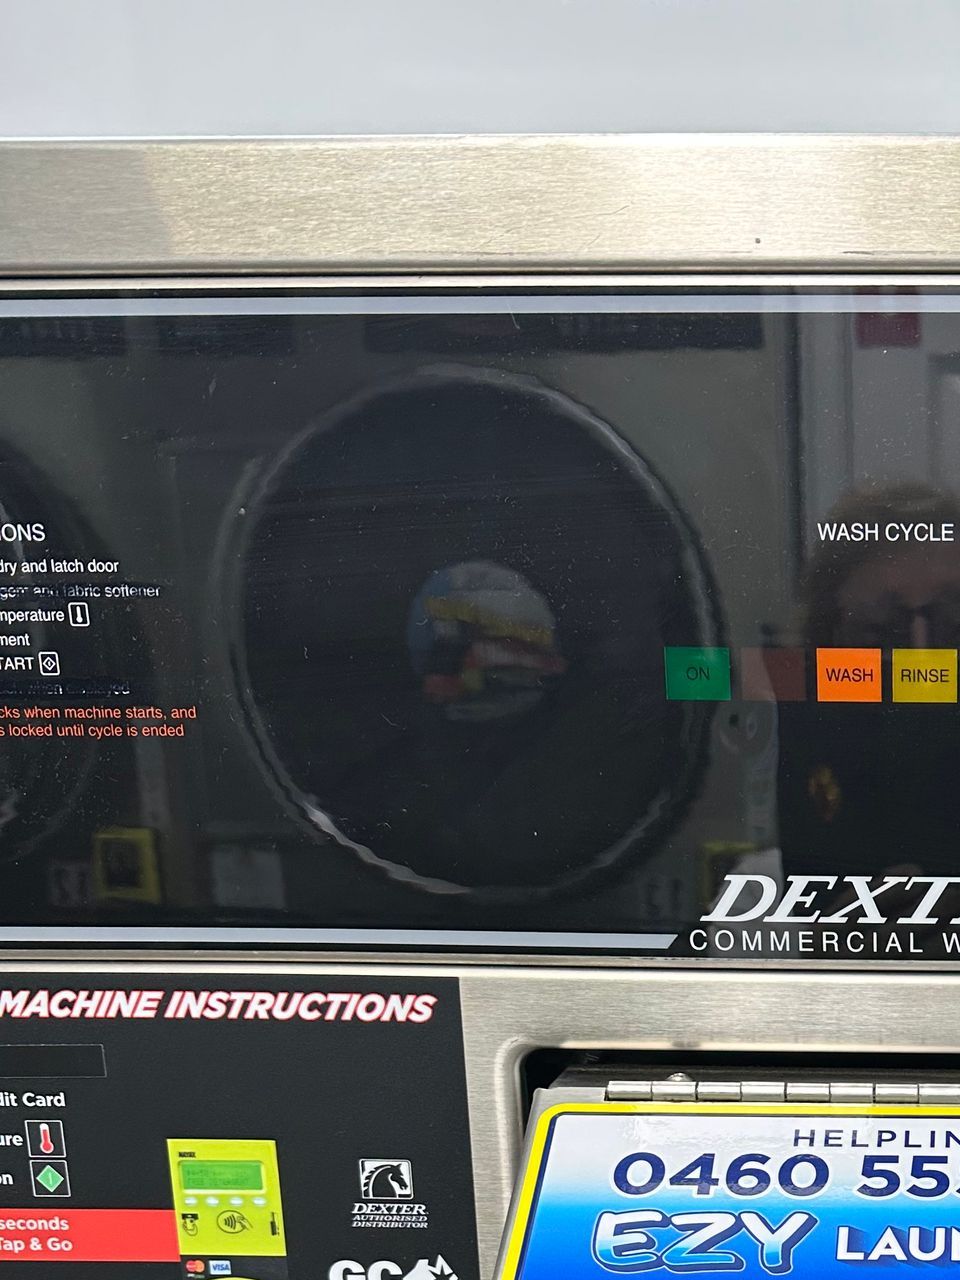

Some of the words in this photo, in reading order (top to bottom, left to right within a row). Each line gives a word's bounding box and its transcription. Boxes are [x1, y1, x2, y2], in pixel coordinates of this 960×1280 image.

[817, 523, 879, 541] WASH
[885, 523, 954, 541] CYCLE
[21, 559, 47, 573] and
[51, 559, 84, 573] latch
[88, 559, 119, 573] door
[104, 584, 161, 597] softener
[686, 667, 710, 681] ON
[825, 668, 874, 683] WASH
[900, 669, 949, 683] RINSE
[24, 706, 60, 719] when
[64, 706, 121, 719] machine
[125, 707, 167, 720] starts,
[171, 706, 197, 719] and
[9, 724, 53, 737] locked
[57, 724, 84, 737] until
[88, 724, 123, 740] cycle
[126, 724, 138, 737] is
[142, 724, 185, 737] ended
[689, 930, 923, 953] COMMERCIAL
[0, 990, 163, 1019] MACHINE
[164, 990, 437, 1022] INSTRUCTIONS
[22, 1092, 66, 1107] Card
[613, 1153, 829, 1197] 0460
[352, 1203, 427, 1214] DEXTER
[0, 1216, 69, 1231] seconds
[352, 1221, 429, 1229] DISTRIBUTOR
[29, 1238, 42, 1251] &
[47, 1238, 73, 1251] Go
[591, 1210, 818, 1276] EZY
